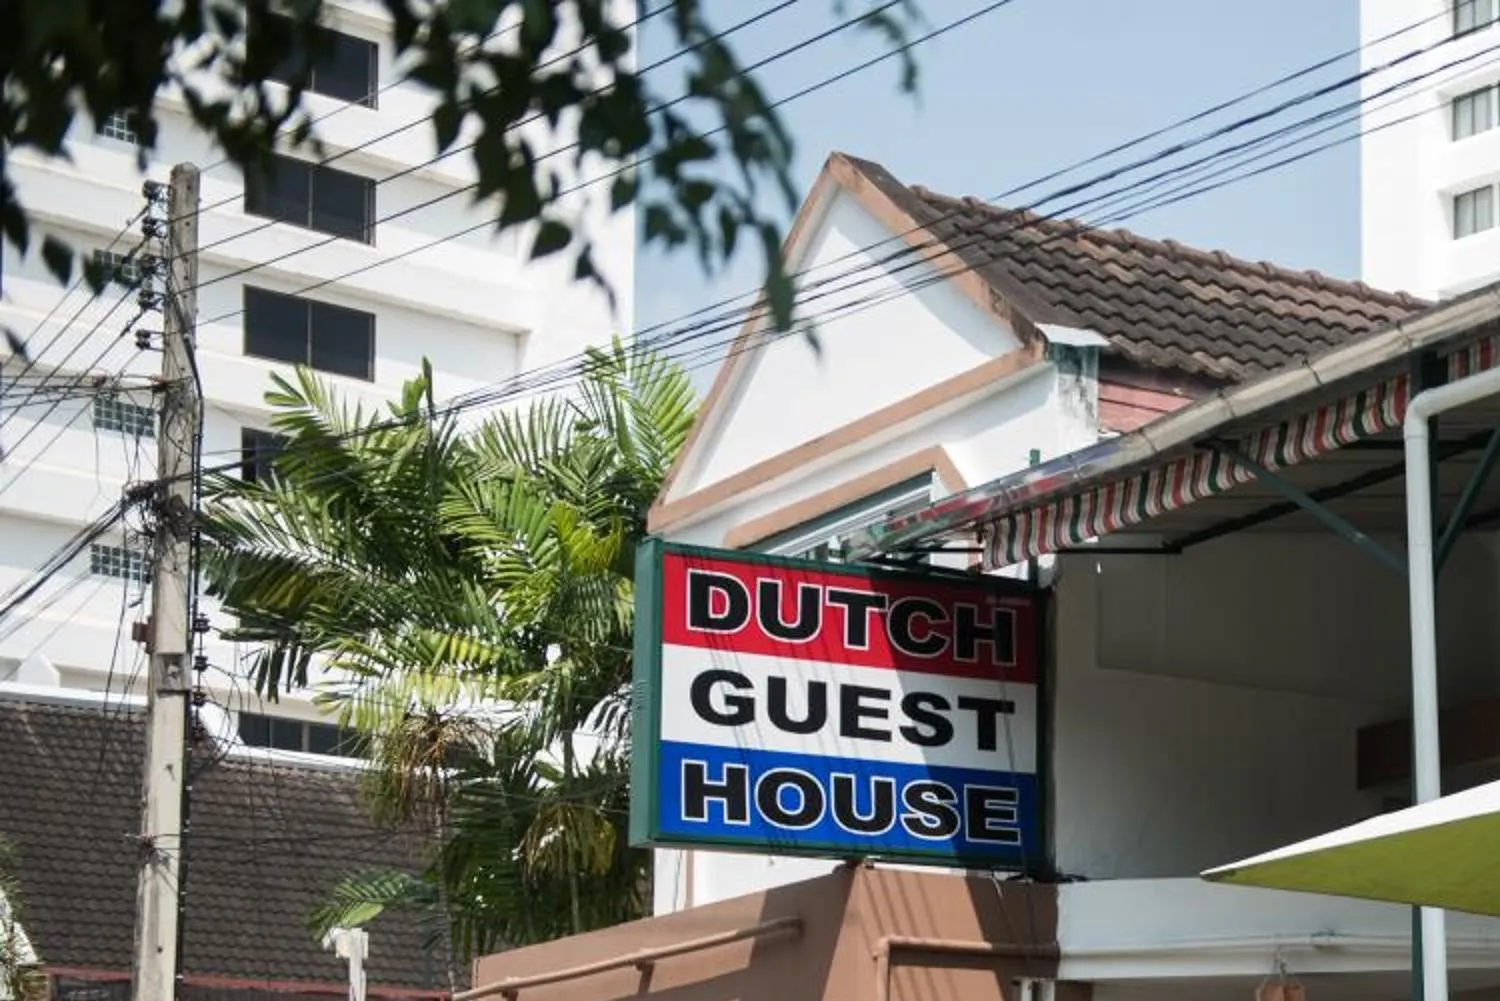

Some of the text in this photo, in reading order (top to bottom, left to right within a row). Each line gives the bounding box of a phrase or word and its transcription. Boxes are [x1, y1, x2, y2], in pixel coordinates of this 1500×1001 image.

[686, 568, 1017, 666] DUTCH
[689, 669, 1016, 751] GUEST
[681, 758, 1022, 844] HOUSE
